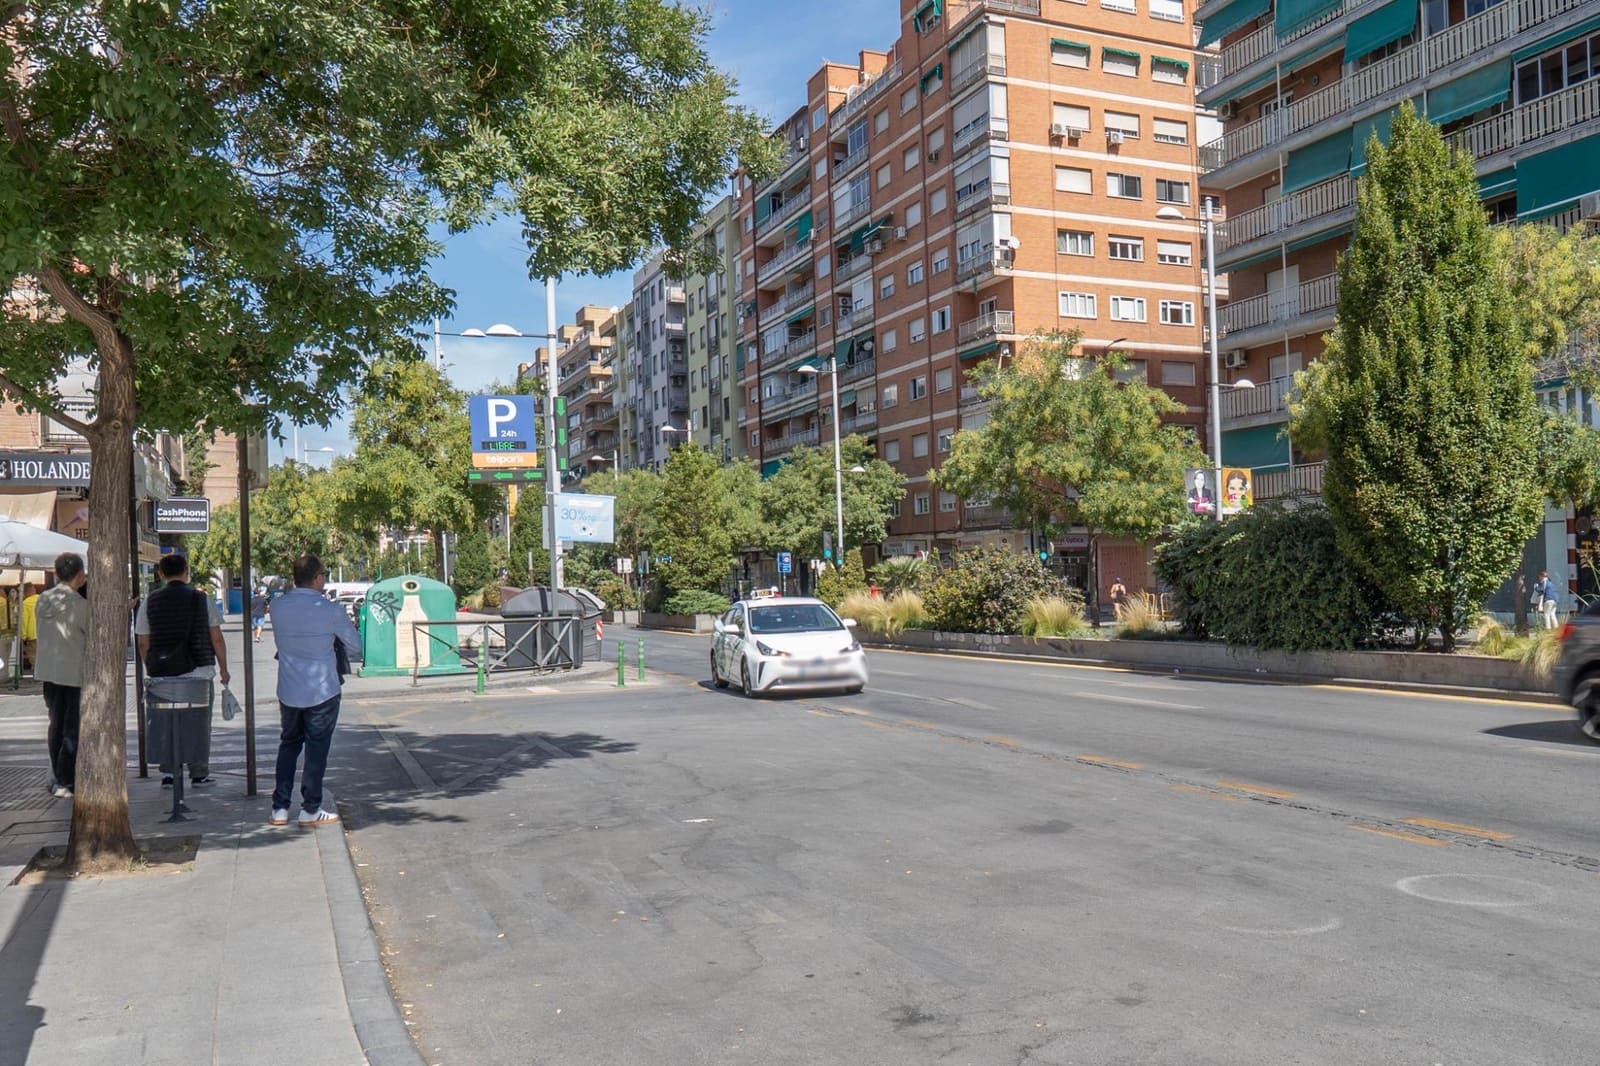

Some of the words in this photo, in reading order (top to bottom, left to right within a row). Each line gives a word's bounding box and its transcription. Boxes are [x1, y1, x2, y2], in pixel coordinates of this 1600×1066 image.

[487, 398, 517, 438] P
[500, 430, 517, 438] 24h
[489, 441, 515, 451] LIBRE
[156, 507, 207, 517] CashPhone
